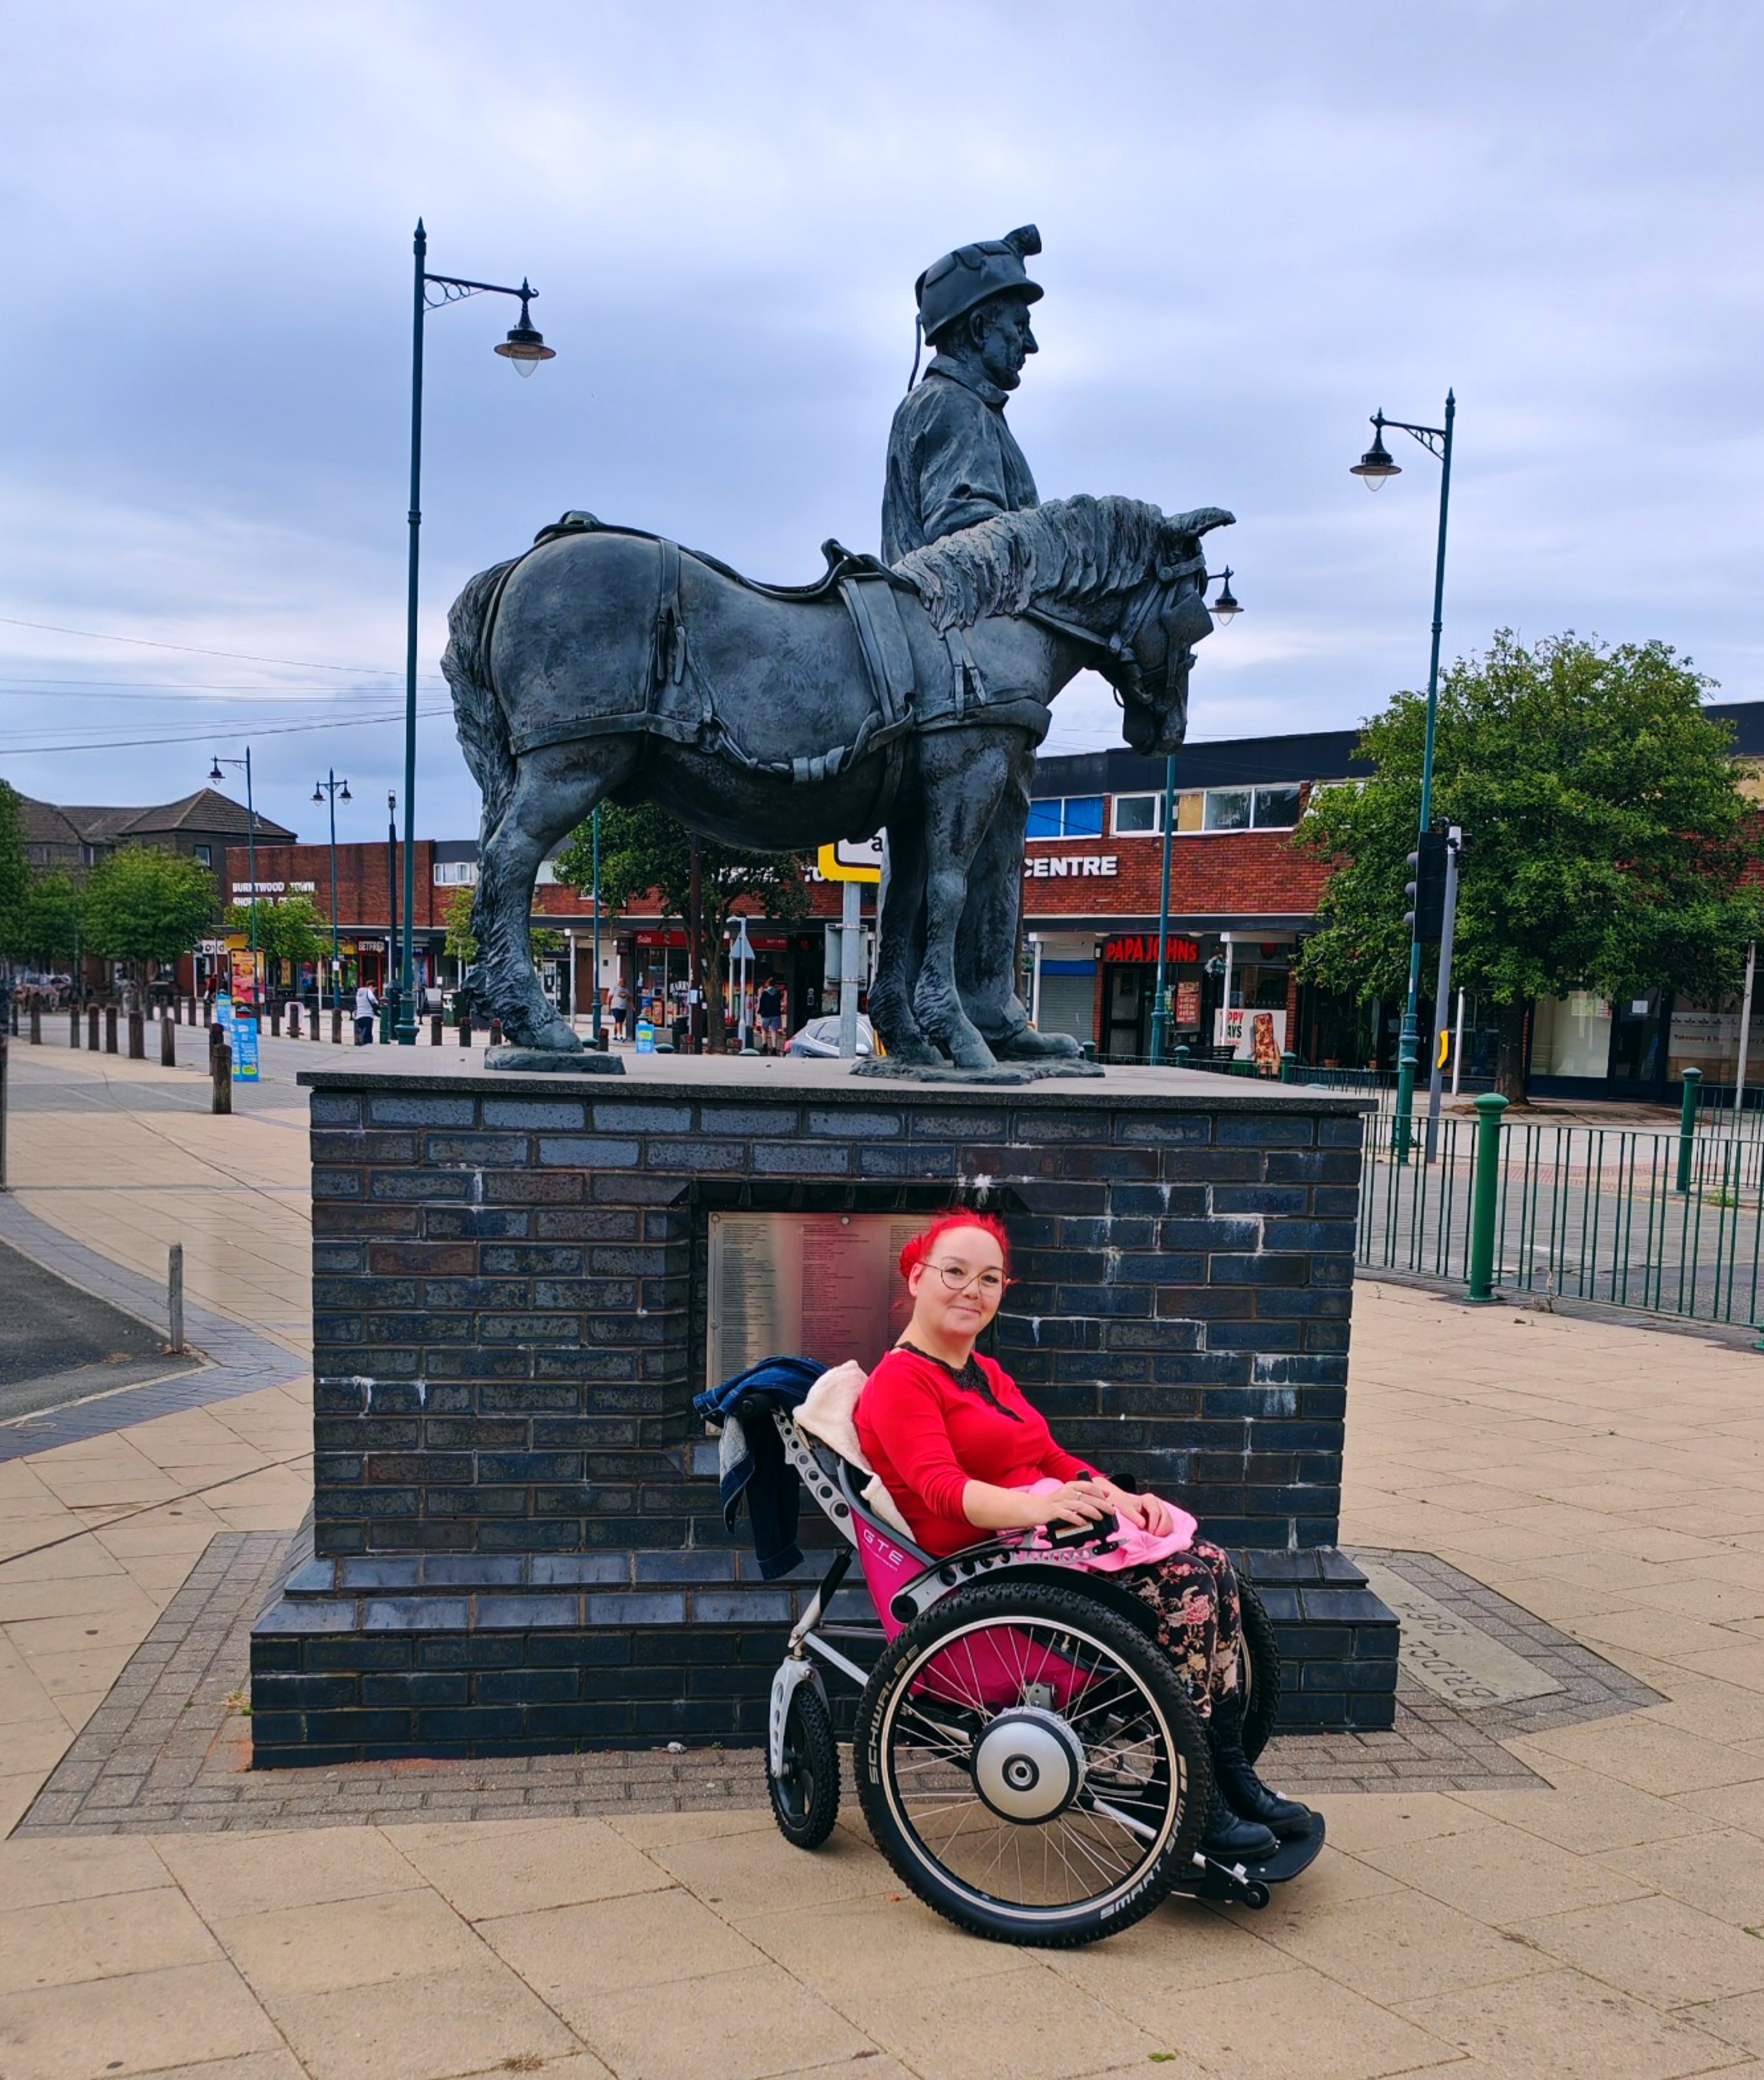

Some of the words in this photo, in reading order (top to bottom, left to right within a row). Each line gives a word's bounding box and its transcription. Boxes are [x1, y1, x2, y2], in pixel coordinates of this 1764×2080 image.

[1106, 936, 1142, 962] PAPA
[863, 1529, 904, 1565] GTE
[869, 1644, 920, 1784] SCHWALBE
[1100, 1856, 1162, 1920] SMART
[1165, 1797, 1187, 1856] SAM
